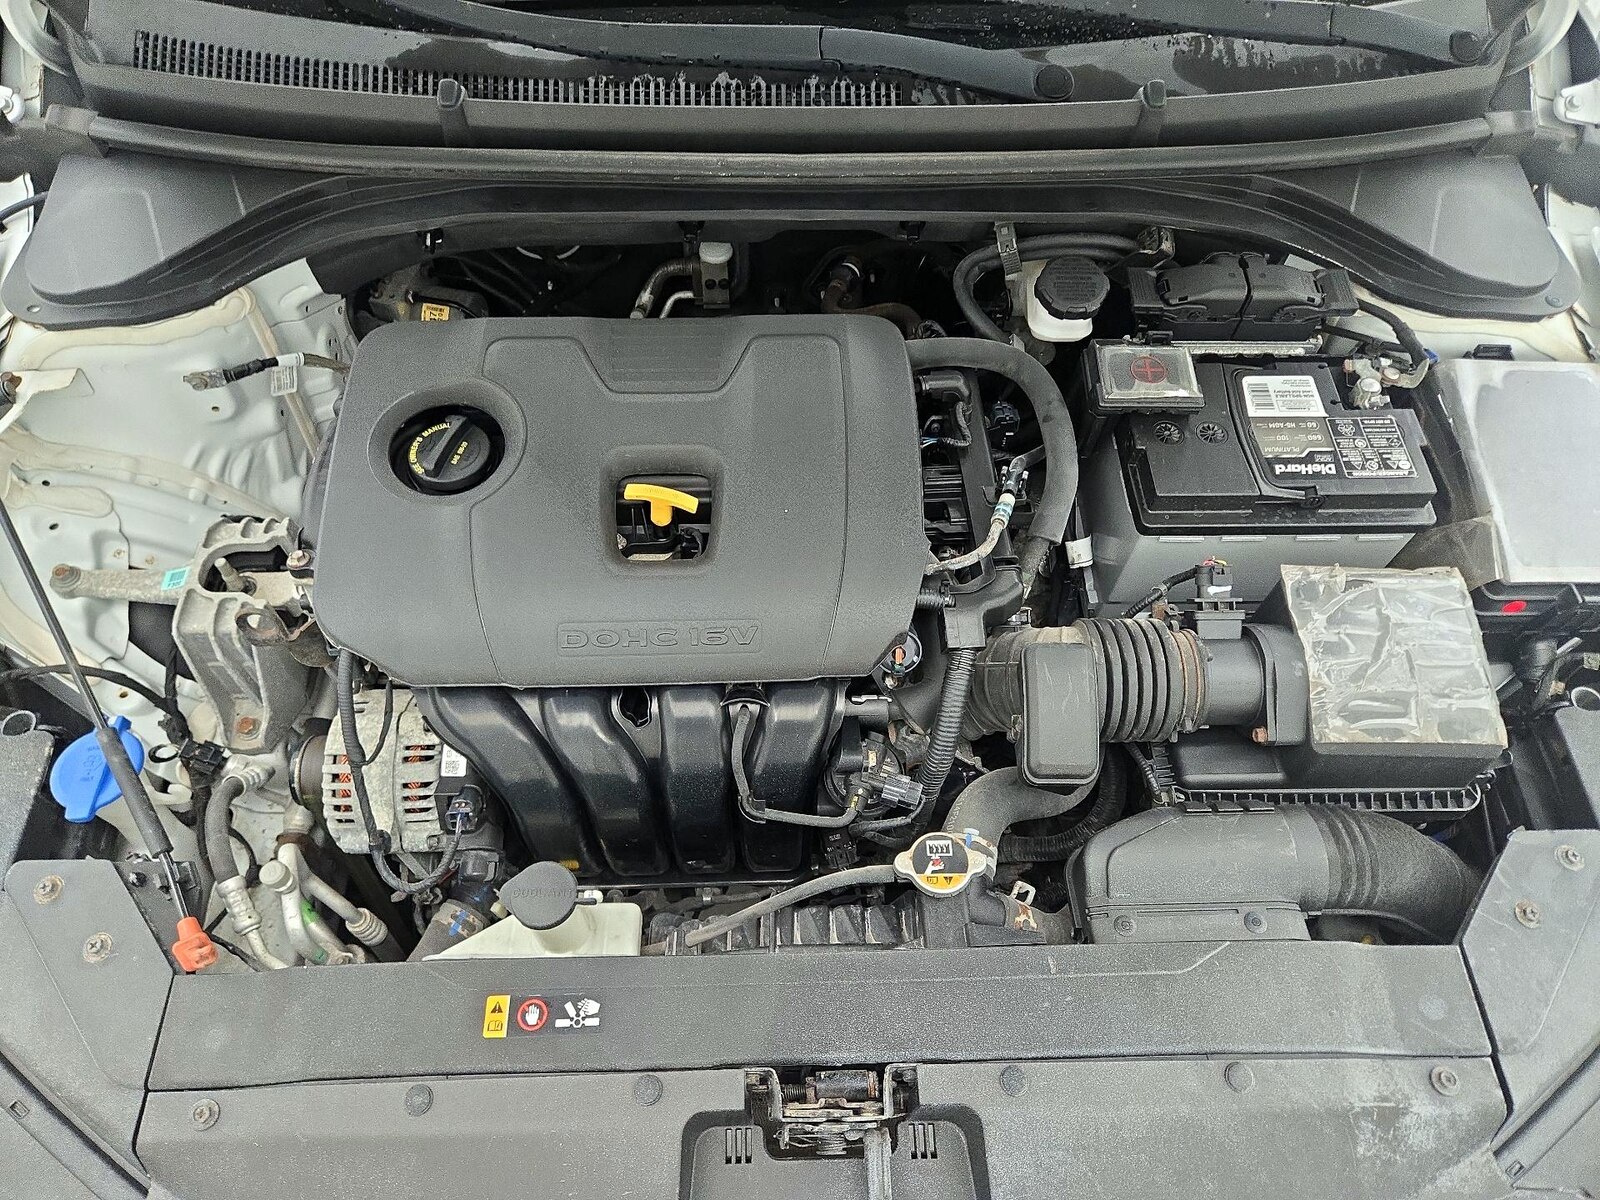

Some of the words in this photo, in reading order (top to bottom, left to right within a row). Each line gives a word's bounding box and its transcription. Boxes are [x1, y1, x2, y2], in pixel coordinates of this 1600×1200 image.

[421, 422, 451, 438] MANUAL
[1274, 464, 1336, 475] DieHard
[560, 627, 679, 649] DOHC
[688, 625, 759, 647] 16V
[513, 887, 574, 898] COOLANT
